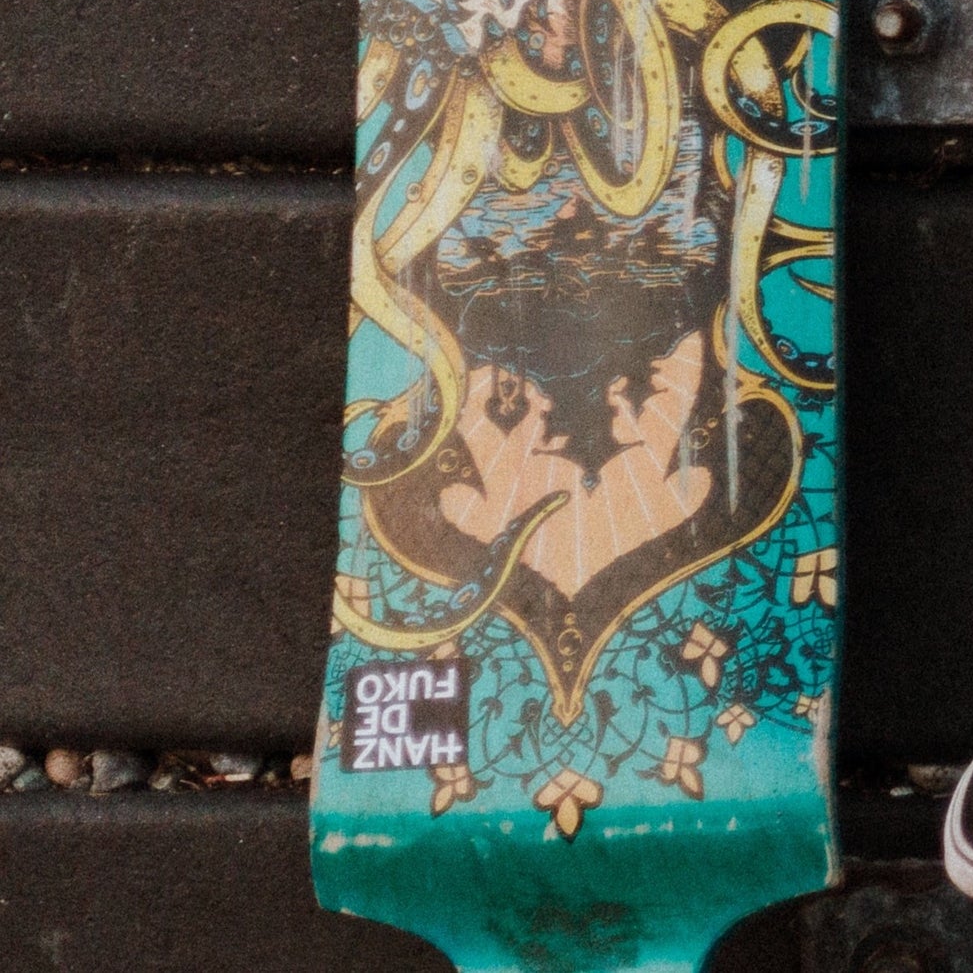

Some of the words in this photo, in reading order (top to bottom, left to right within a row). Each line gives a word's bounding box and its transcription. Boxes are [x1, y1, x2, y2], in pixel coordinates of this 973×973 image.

[356, 668, 456, 704] FUKO
[354, 704, 407, 736] DE
[352, 732, 463, 769] HANZ
